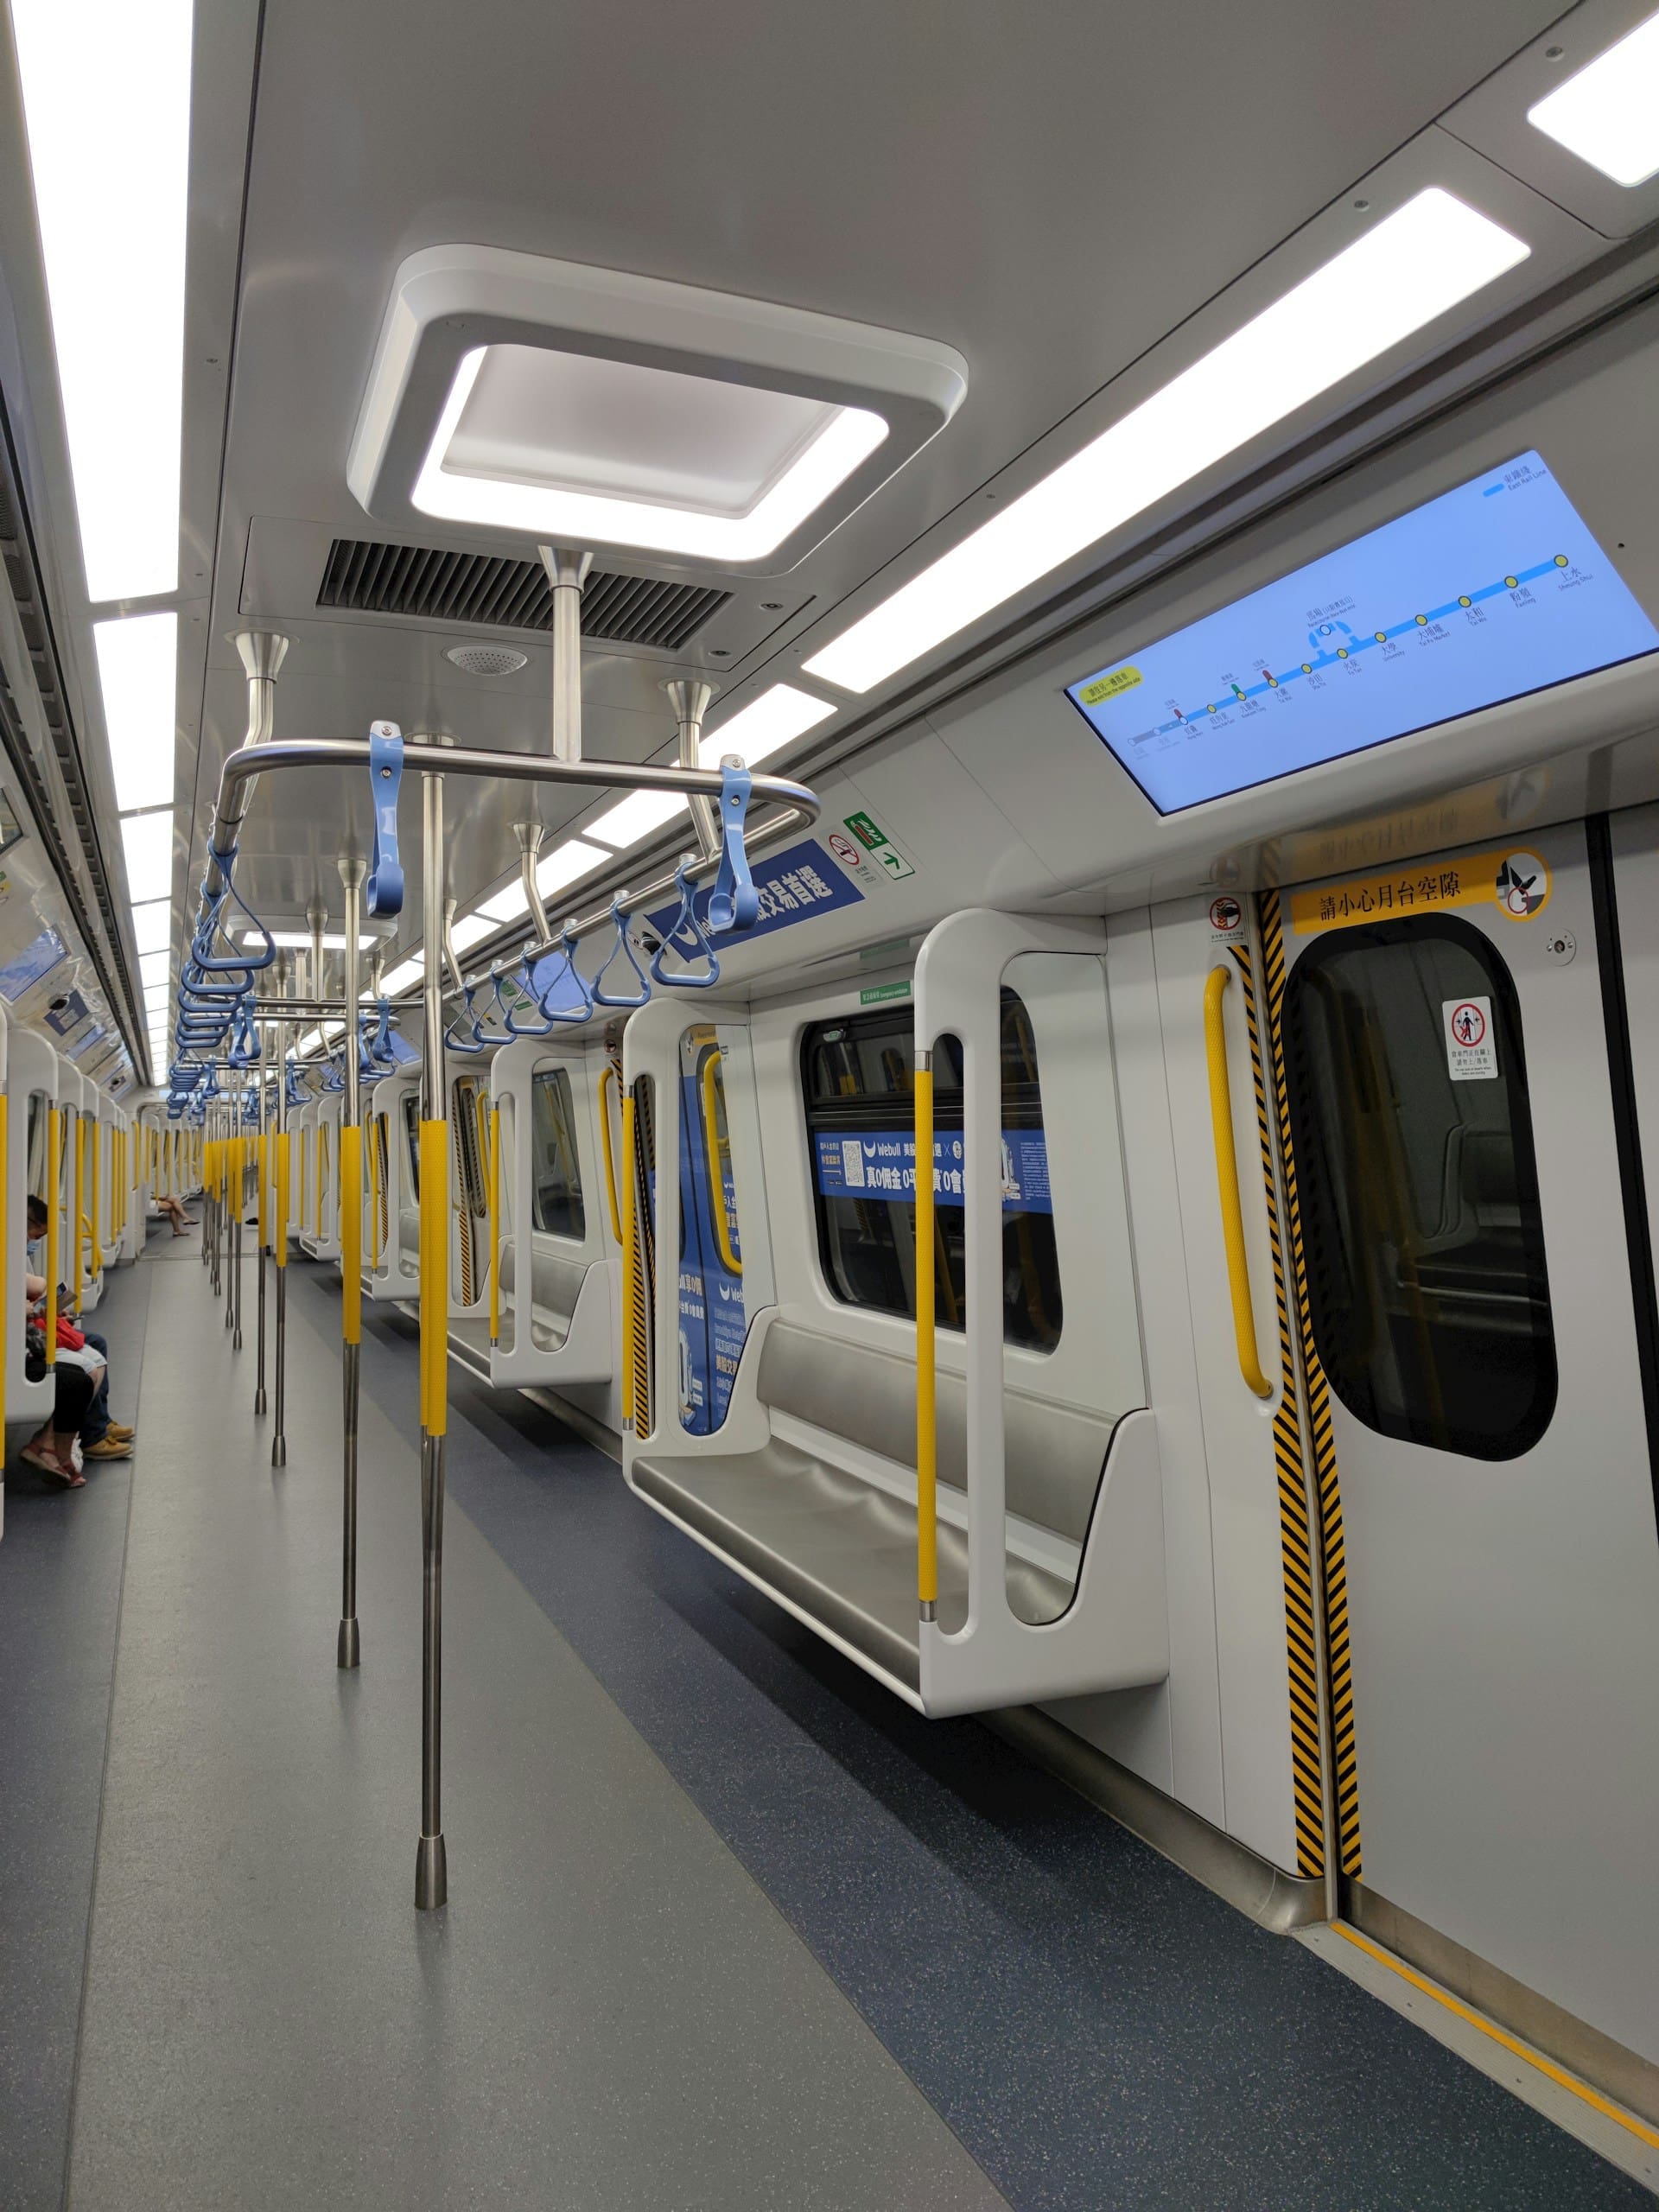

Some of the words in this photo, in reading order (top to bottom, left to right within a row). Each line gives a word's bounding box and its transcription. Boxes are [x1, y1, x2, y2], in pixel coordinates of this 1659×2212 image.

[1508, 481, 1521, 491] East
[1521, 474, 1533, 484] Rail
[1532, 469, 1547, 479] Line
[1560, 567, 1581, 582] 上水
[1465, 607, 1484, 621] 太和
[1319, 871, 1461, 921] 請小心月台空隙
[877, 1142, 901, 1156] Webull
